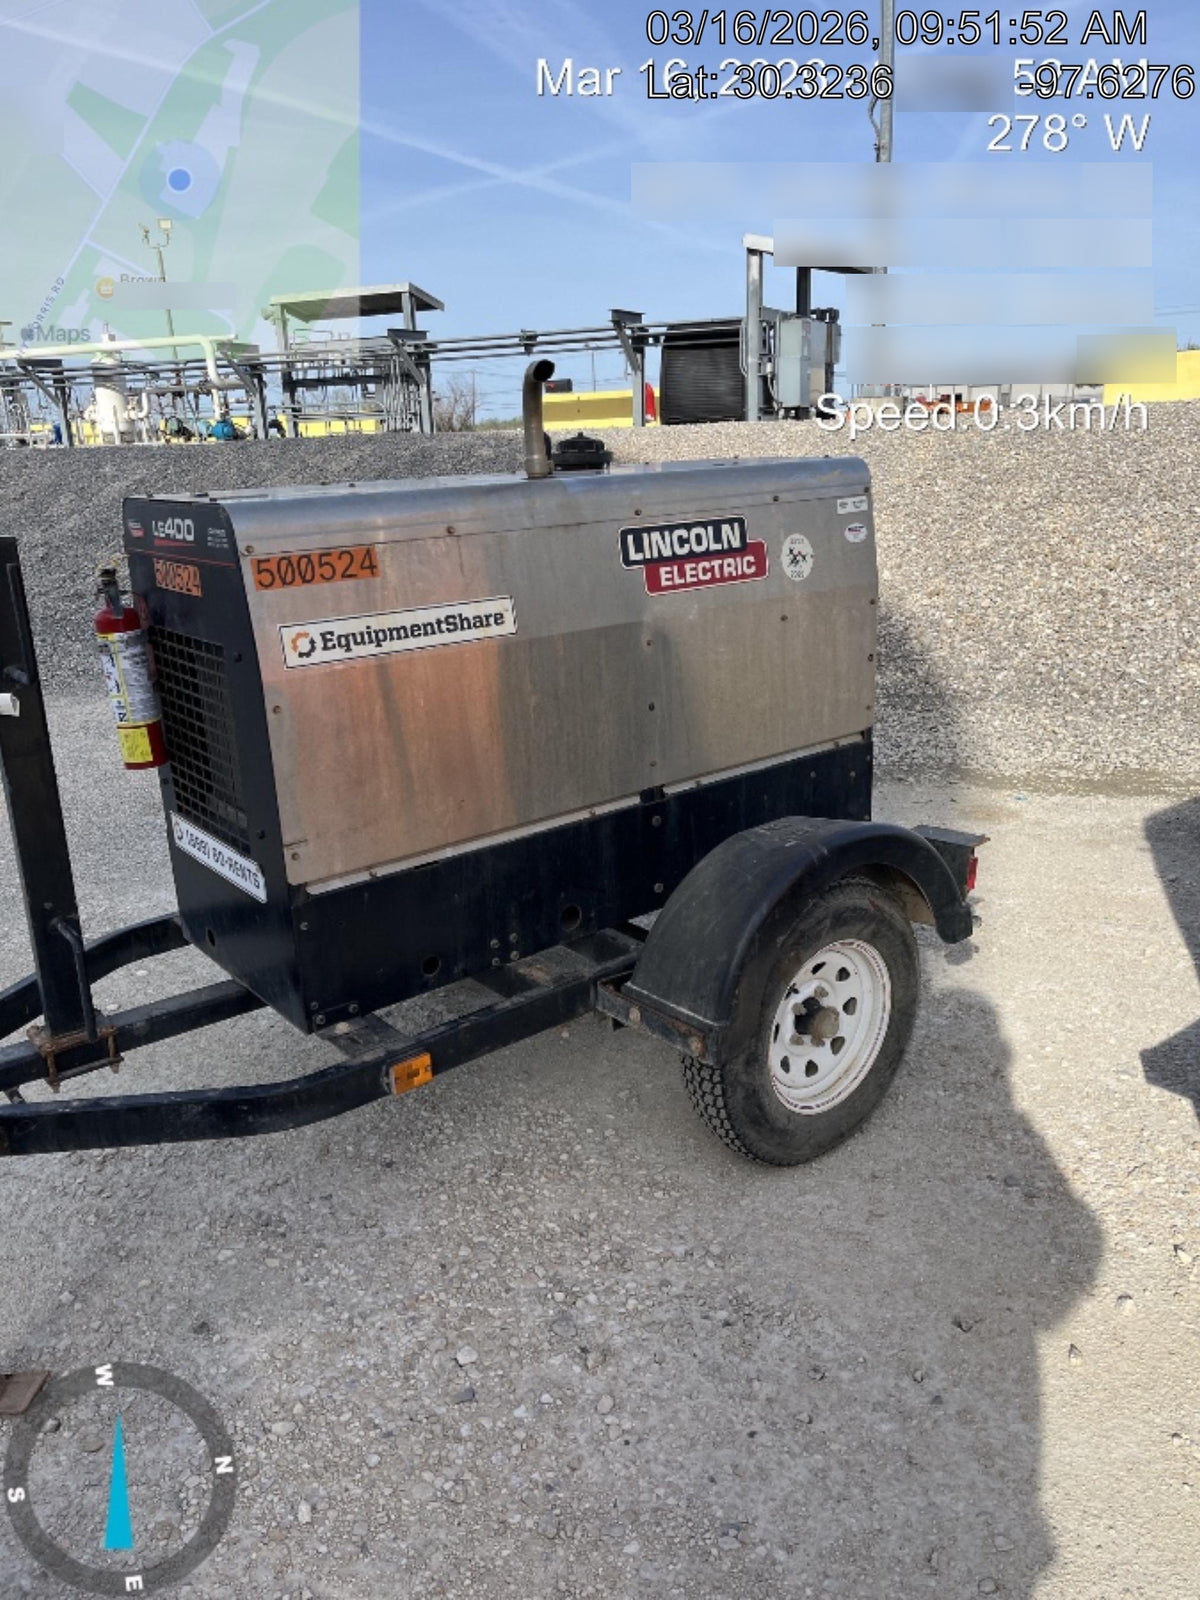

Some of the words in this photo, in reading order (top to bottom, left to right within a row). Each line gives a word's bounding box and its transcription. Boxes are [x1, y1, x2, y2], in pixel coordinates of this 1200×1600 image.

[626, 521, 742, 562] LINCOLN
[256, 547, 378, 588] 500524
[659, 555, 757, 587] ELECTRIC
[319, 609, 506, 652] EquipmentShare
